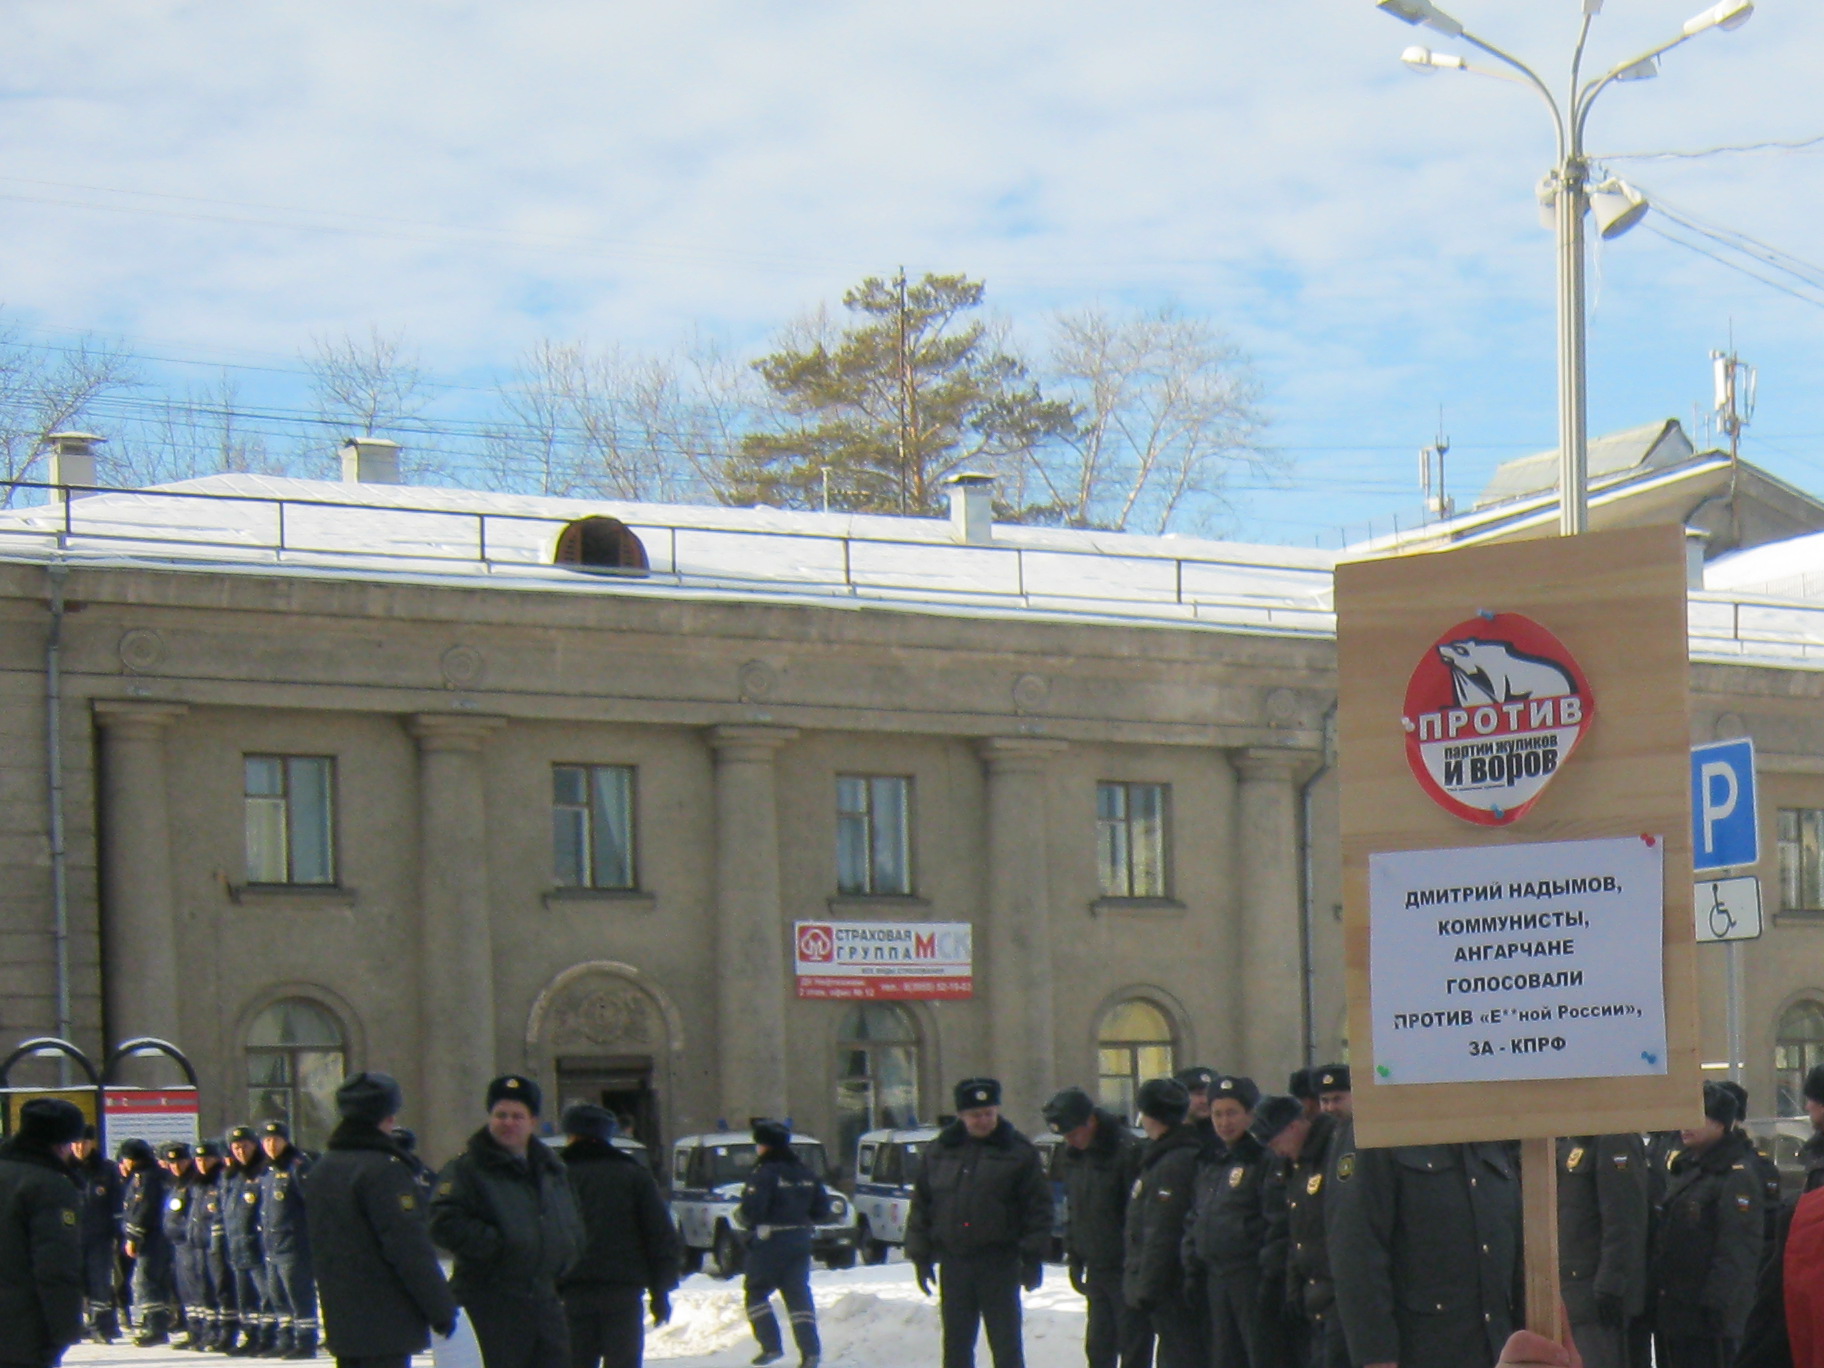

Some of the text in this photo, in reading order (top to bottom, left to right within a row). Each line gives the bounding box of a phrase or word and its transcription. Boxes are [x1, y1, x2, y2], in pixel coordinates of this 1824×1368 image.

[1419, 697, 1583, 741] ПРОТИВ
[1702, 761, 1738, 853] P
[1404, 876, 1623, 909] ДМИТРИЙ НАДЫМОВ,
[1438, 910, 1590, 936] КОММУНИСТЫ,
[835, 929, 912, 942] СТРАХОВАЯ
[836, 946, 912, 960] ГРУППА
[1453, 939, 1575, 962] АНГАРЧАНЕ
[1446, 970, 1584, 995] ГОЛОСОВАЛИ
[1394, 1010, 1474, 1030] ПРОТИВ
[1469, 1041, 1494, 1056] ЗА
[1511, 1036, 1567, 1054] КПРФ
